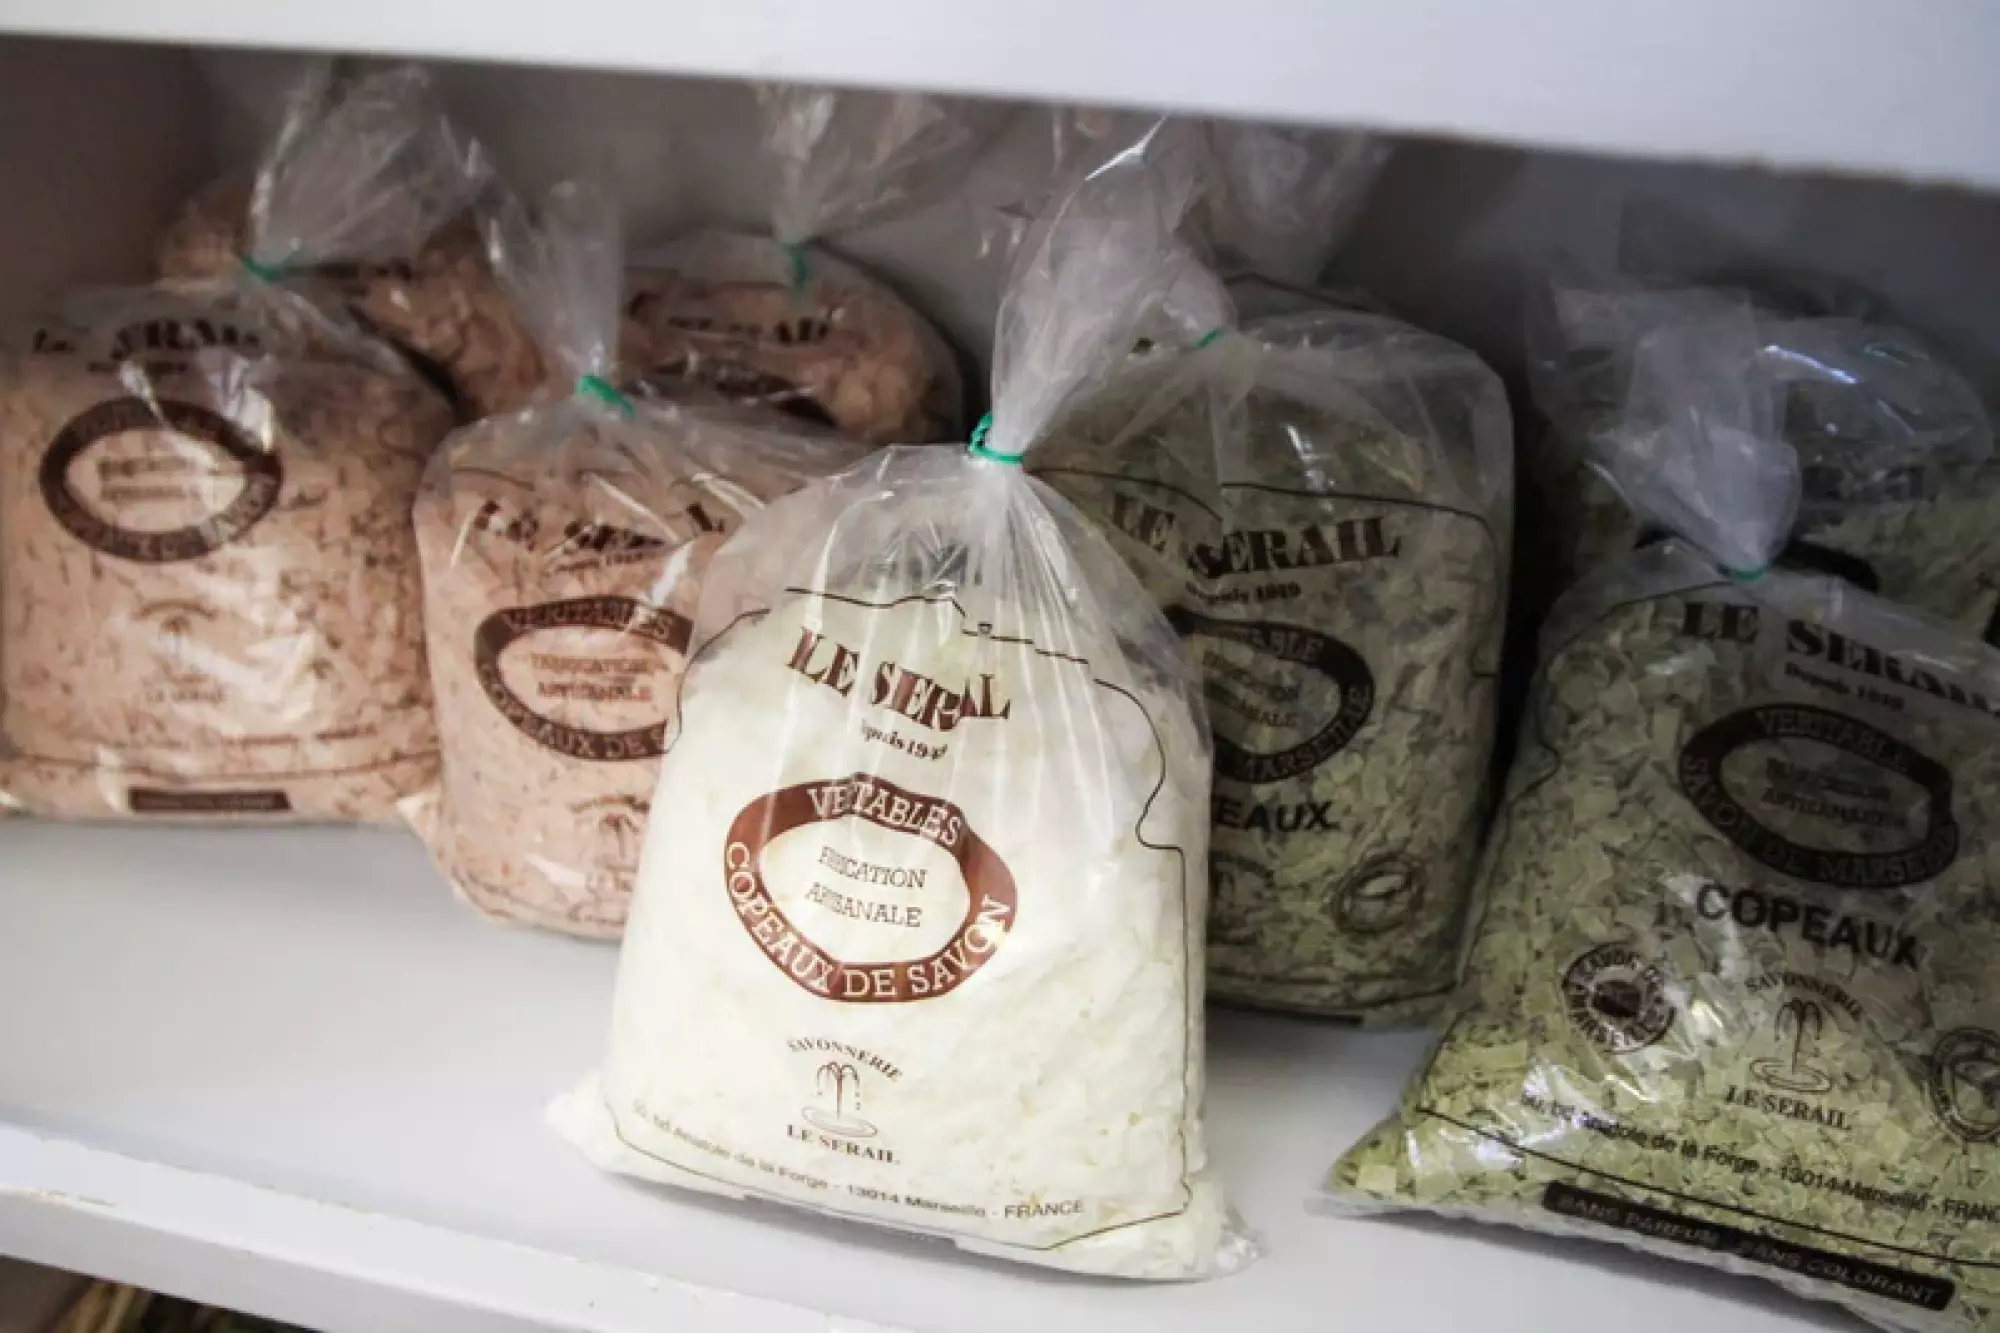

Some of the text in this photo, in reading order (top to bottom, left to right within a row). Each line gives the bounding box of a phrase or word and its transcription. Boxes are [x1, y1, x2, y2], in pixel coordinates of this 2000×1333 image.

[786, 626, 859, 698] LE
[1218, 800, 1340, 832] EAUX
[726, 841, 835, 995] COPEAUX
[842, 968, 897, 997] DE
[1695, 882, 1920, 971] COPEAUX
[1703, 1143, 1760, 1174] Forge
[1003, 1199, 1085, 1221] FRANCE
